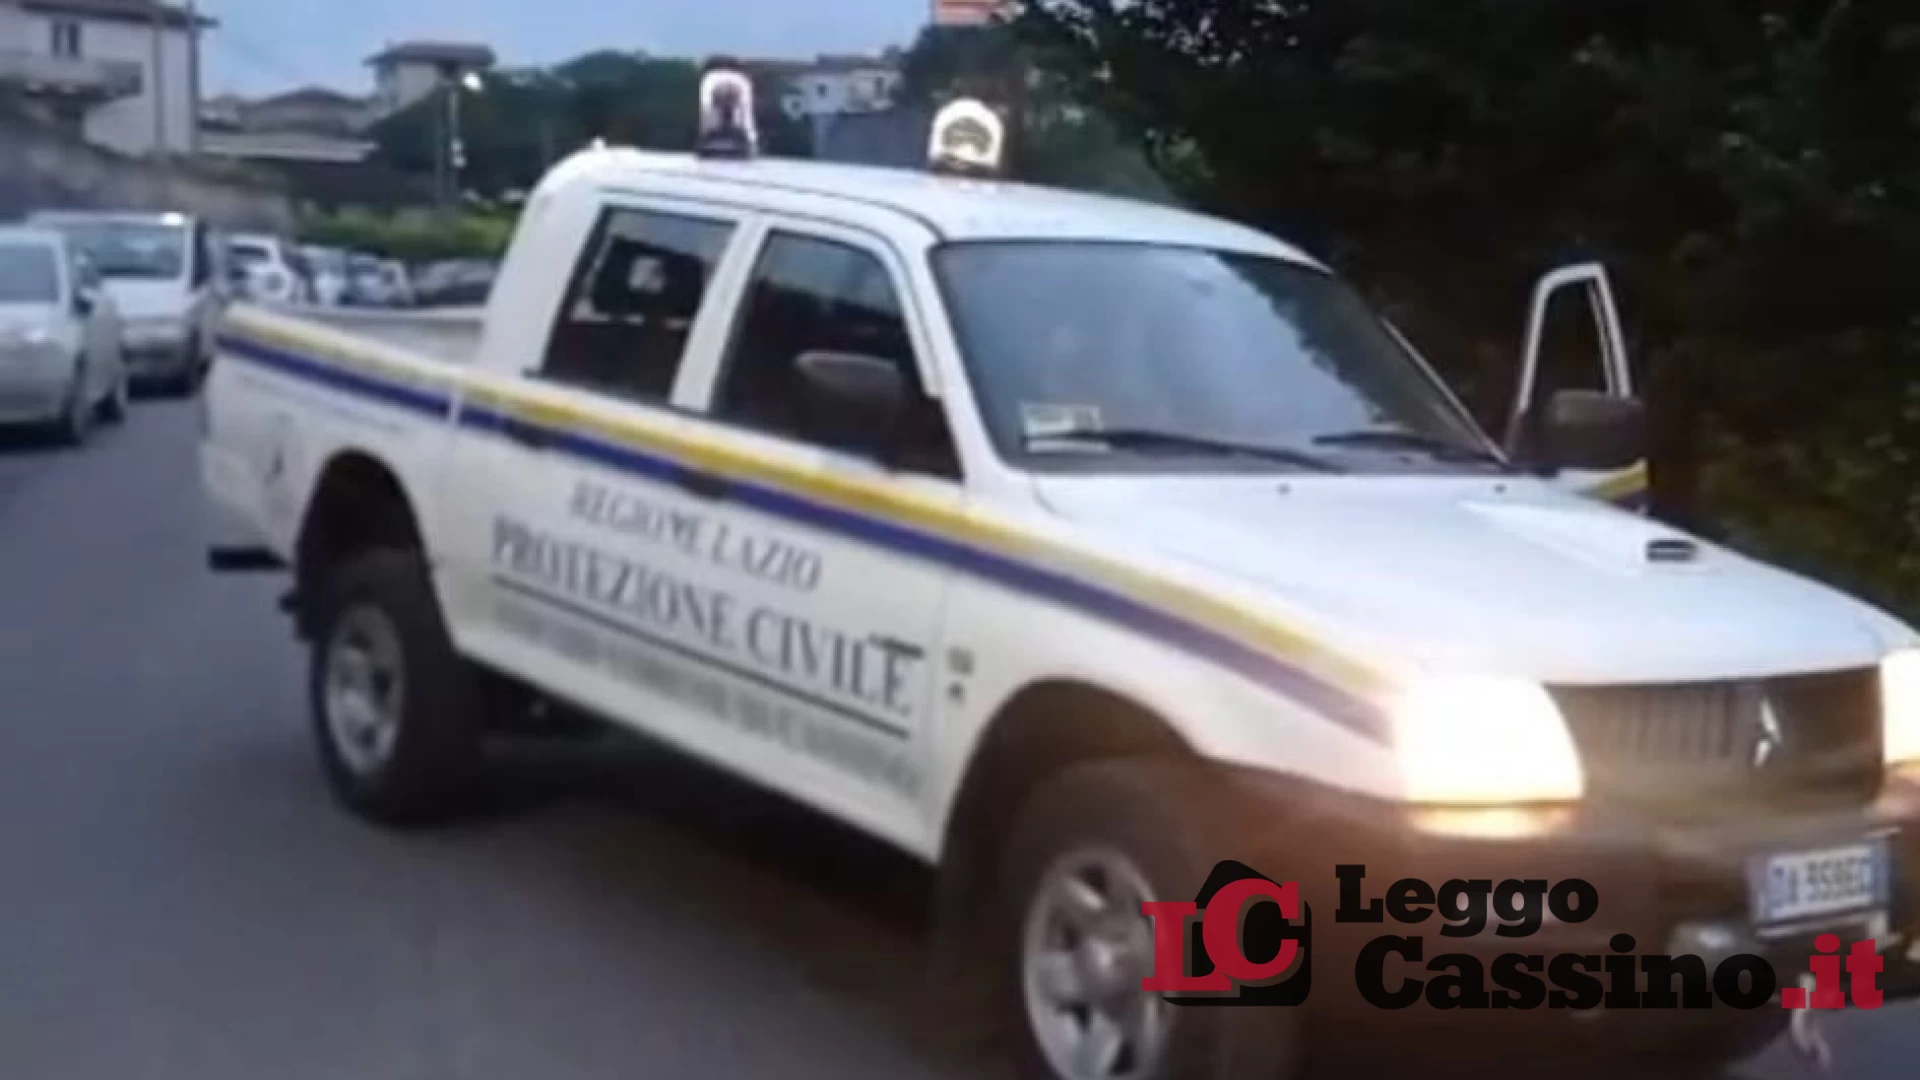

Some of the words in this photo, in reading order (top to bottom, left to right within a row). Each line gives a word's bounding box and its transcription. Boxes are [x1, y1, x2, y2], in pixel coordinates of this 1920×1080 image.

[491, 513, 736, 650] PROTEZIONE
[746, 606, 913, 717] CIVILE
[710, 523, 824, 592] LAZIO
